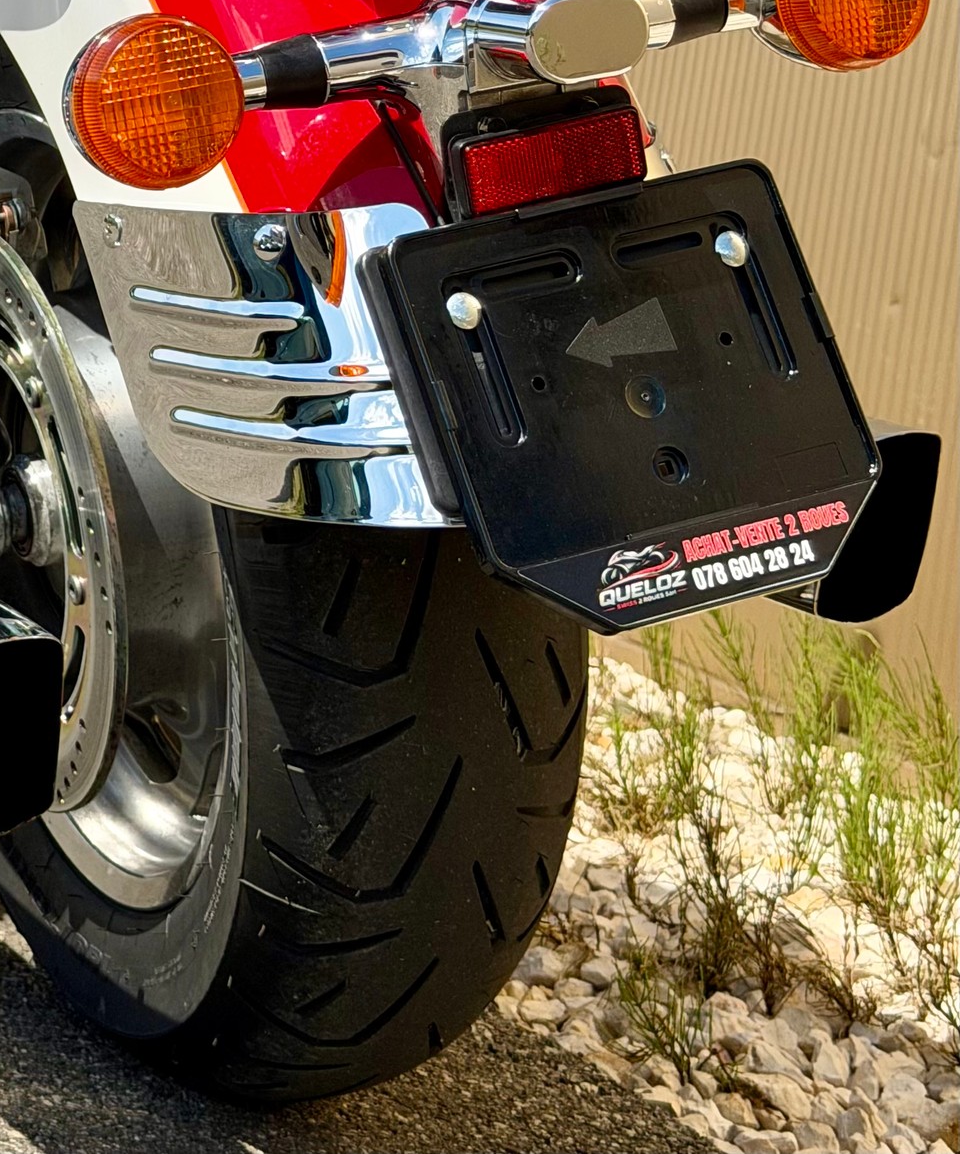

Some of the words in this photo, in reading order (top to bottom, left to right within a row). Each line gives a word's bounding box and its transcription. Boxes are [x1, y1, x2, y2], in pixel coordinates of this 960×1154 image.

[682, 517, 783, 562] ACHAT-VENTE
[784, 513, 799, 536] 2
[797, 500, 849, 534] ROUES
[691, 565, 728, 591] 078
[728, 557, 765, 582] 604
[765, 549, 789, 573] 28
[790, 539, 815, 566] 24
[599, 570, 687, 607] QUELOZ
[643, 592, 665, 603] ROUES
